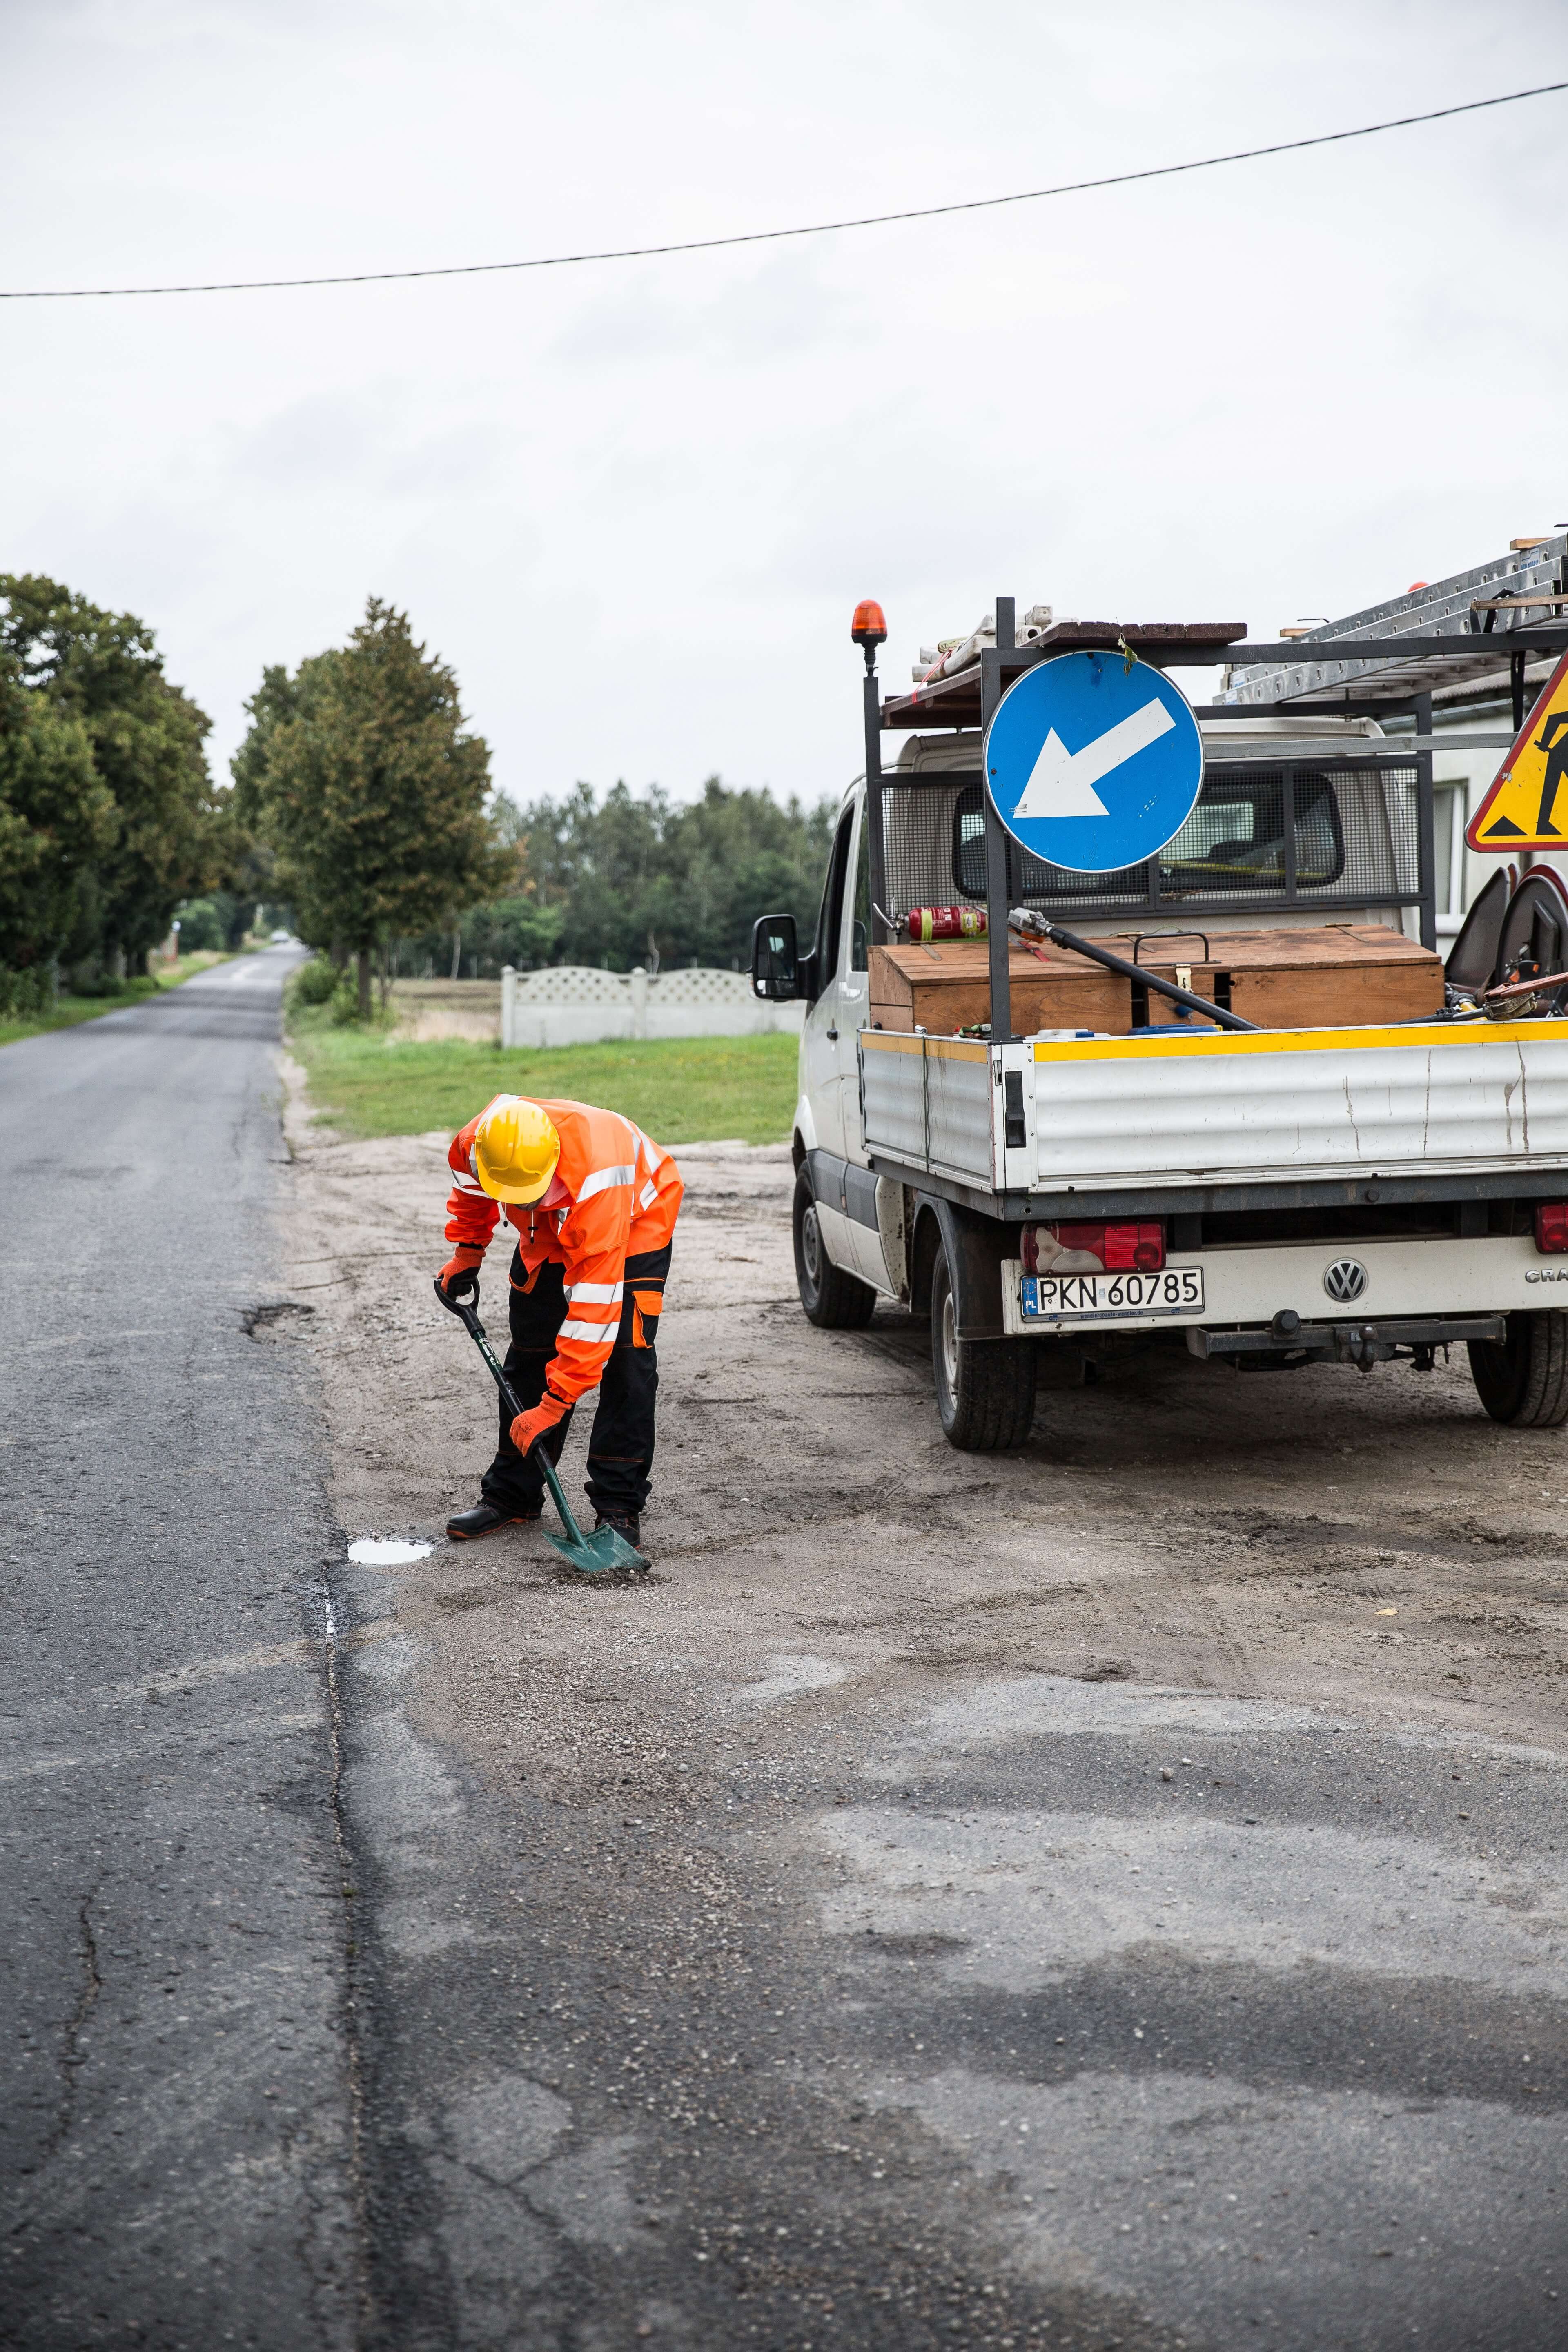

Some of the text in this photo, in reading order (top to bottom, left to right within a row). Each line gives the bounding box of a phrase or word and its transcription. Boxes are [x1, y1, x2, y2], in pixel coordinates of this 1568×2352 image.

[1325, 1261, 1366, 1301] VW
[1525, 1268, 1568, 1283] CRA
[1040, 1273, 1198, 1310] PKN 60785
[1026, 1300, 1036, 1308] PL
[1080, 1310, 1143, 1319] wendler@auto-wendler.de
